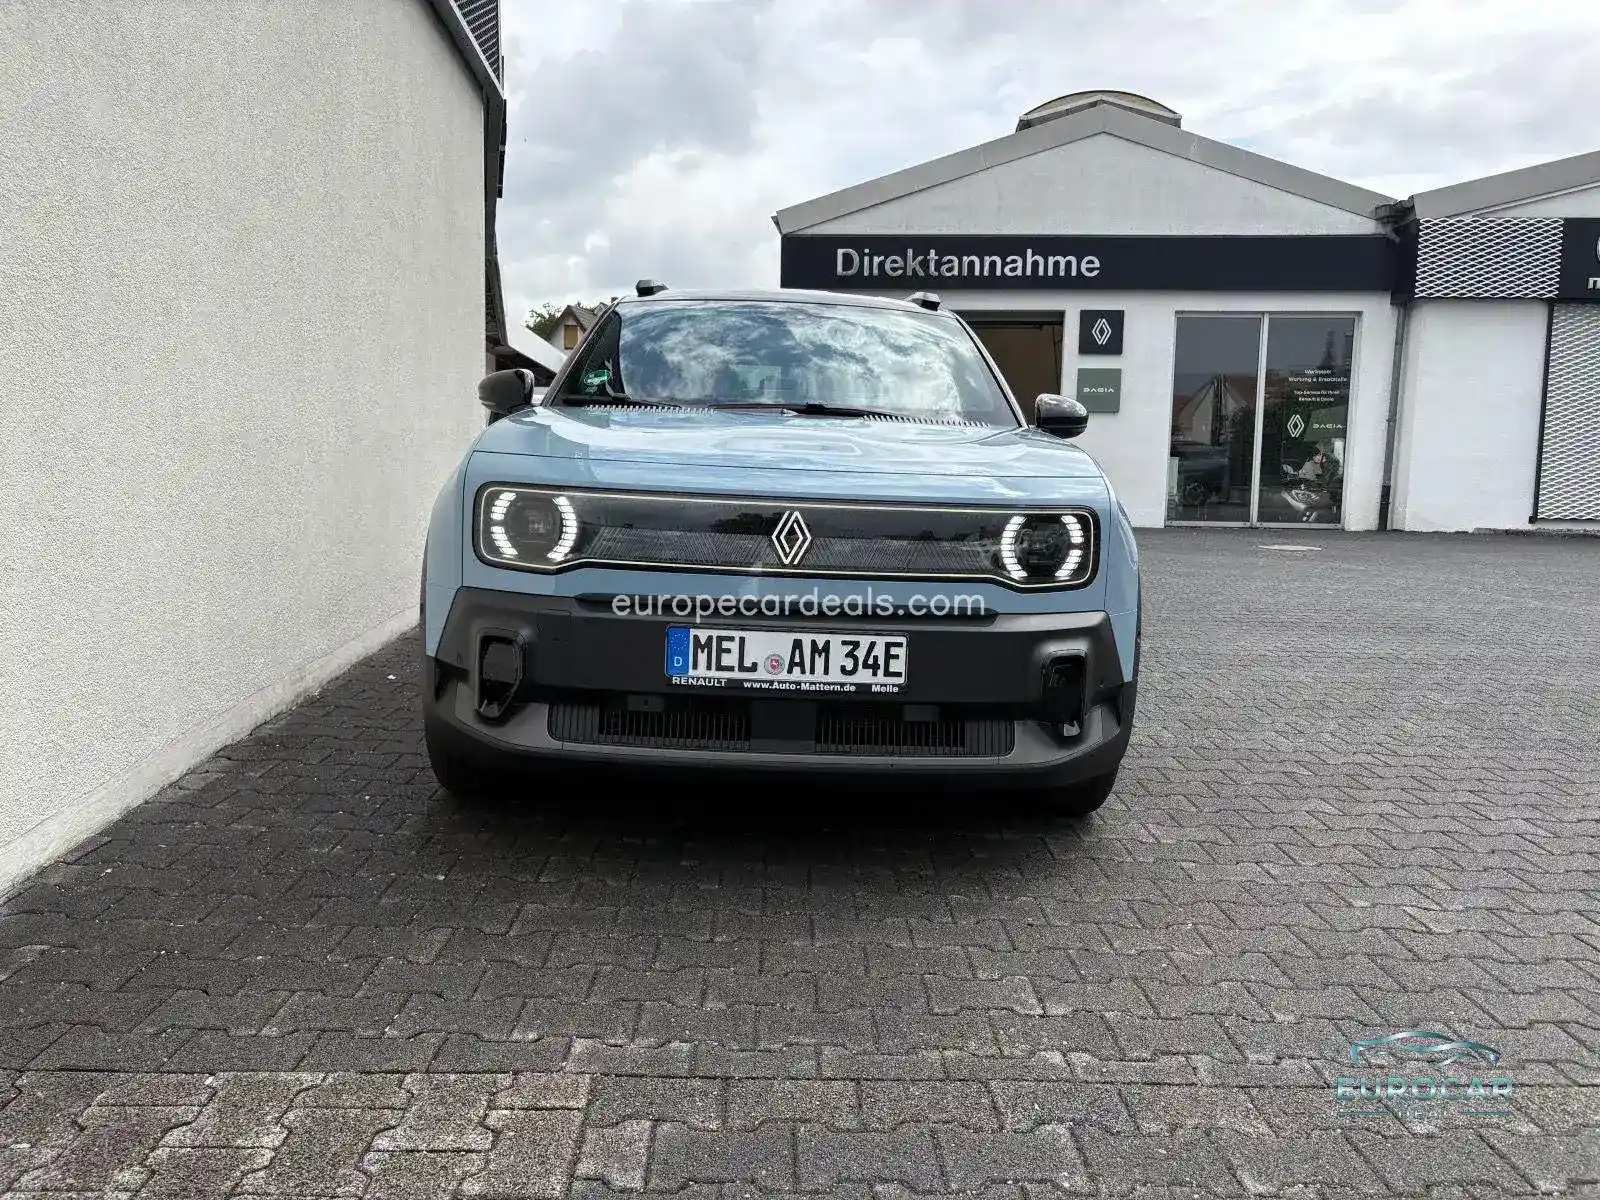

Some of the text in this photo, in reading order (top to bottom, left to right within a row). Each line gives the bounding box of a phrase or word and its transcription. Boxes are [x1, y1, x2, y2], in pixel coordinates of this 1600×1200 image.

[836, 248, 1101, 277] Direktannahme
[673, 656, 683, 667] D
[691, 634, 904, 678] MEL AM 34E
[672, 676, 899, 693] RENAULT www.Auto-Mattern.de Melle
